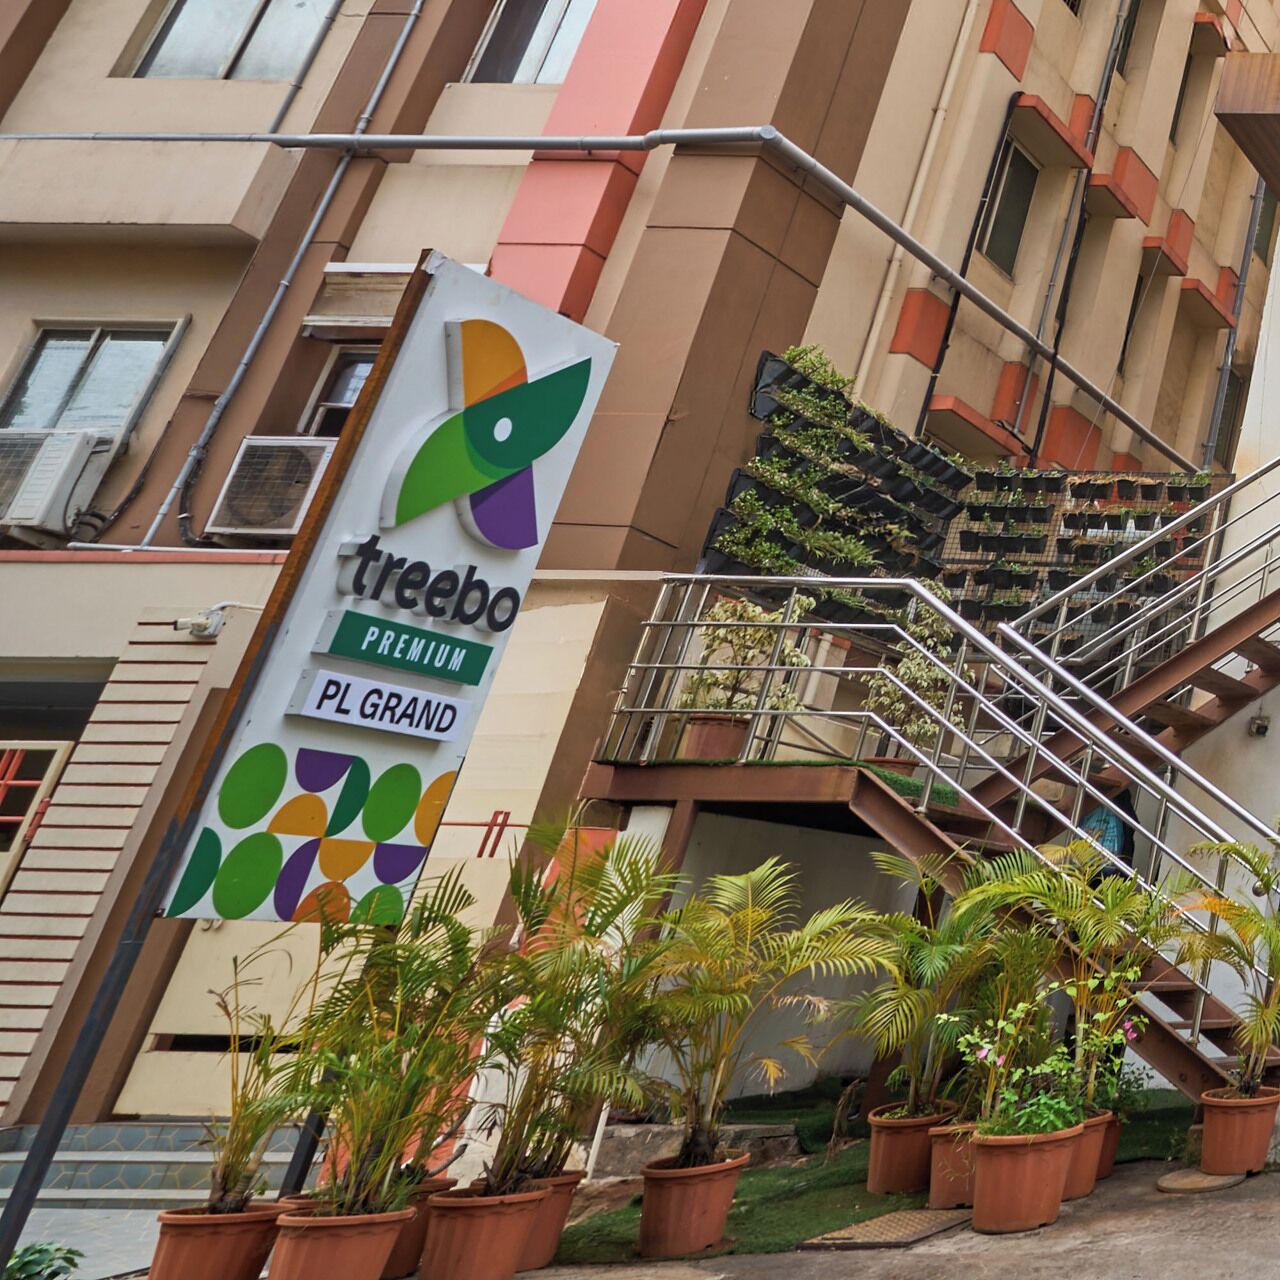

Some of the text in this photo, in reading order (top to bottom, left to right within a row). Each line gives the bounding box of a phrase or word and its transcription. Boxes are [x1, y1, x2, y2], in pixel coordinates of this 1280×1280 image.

[352, 534, 520, 632] treebo
[362, 626, 466, 671] PREMIUM
[316, 679, 457, 734] PL GRAND
